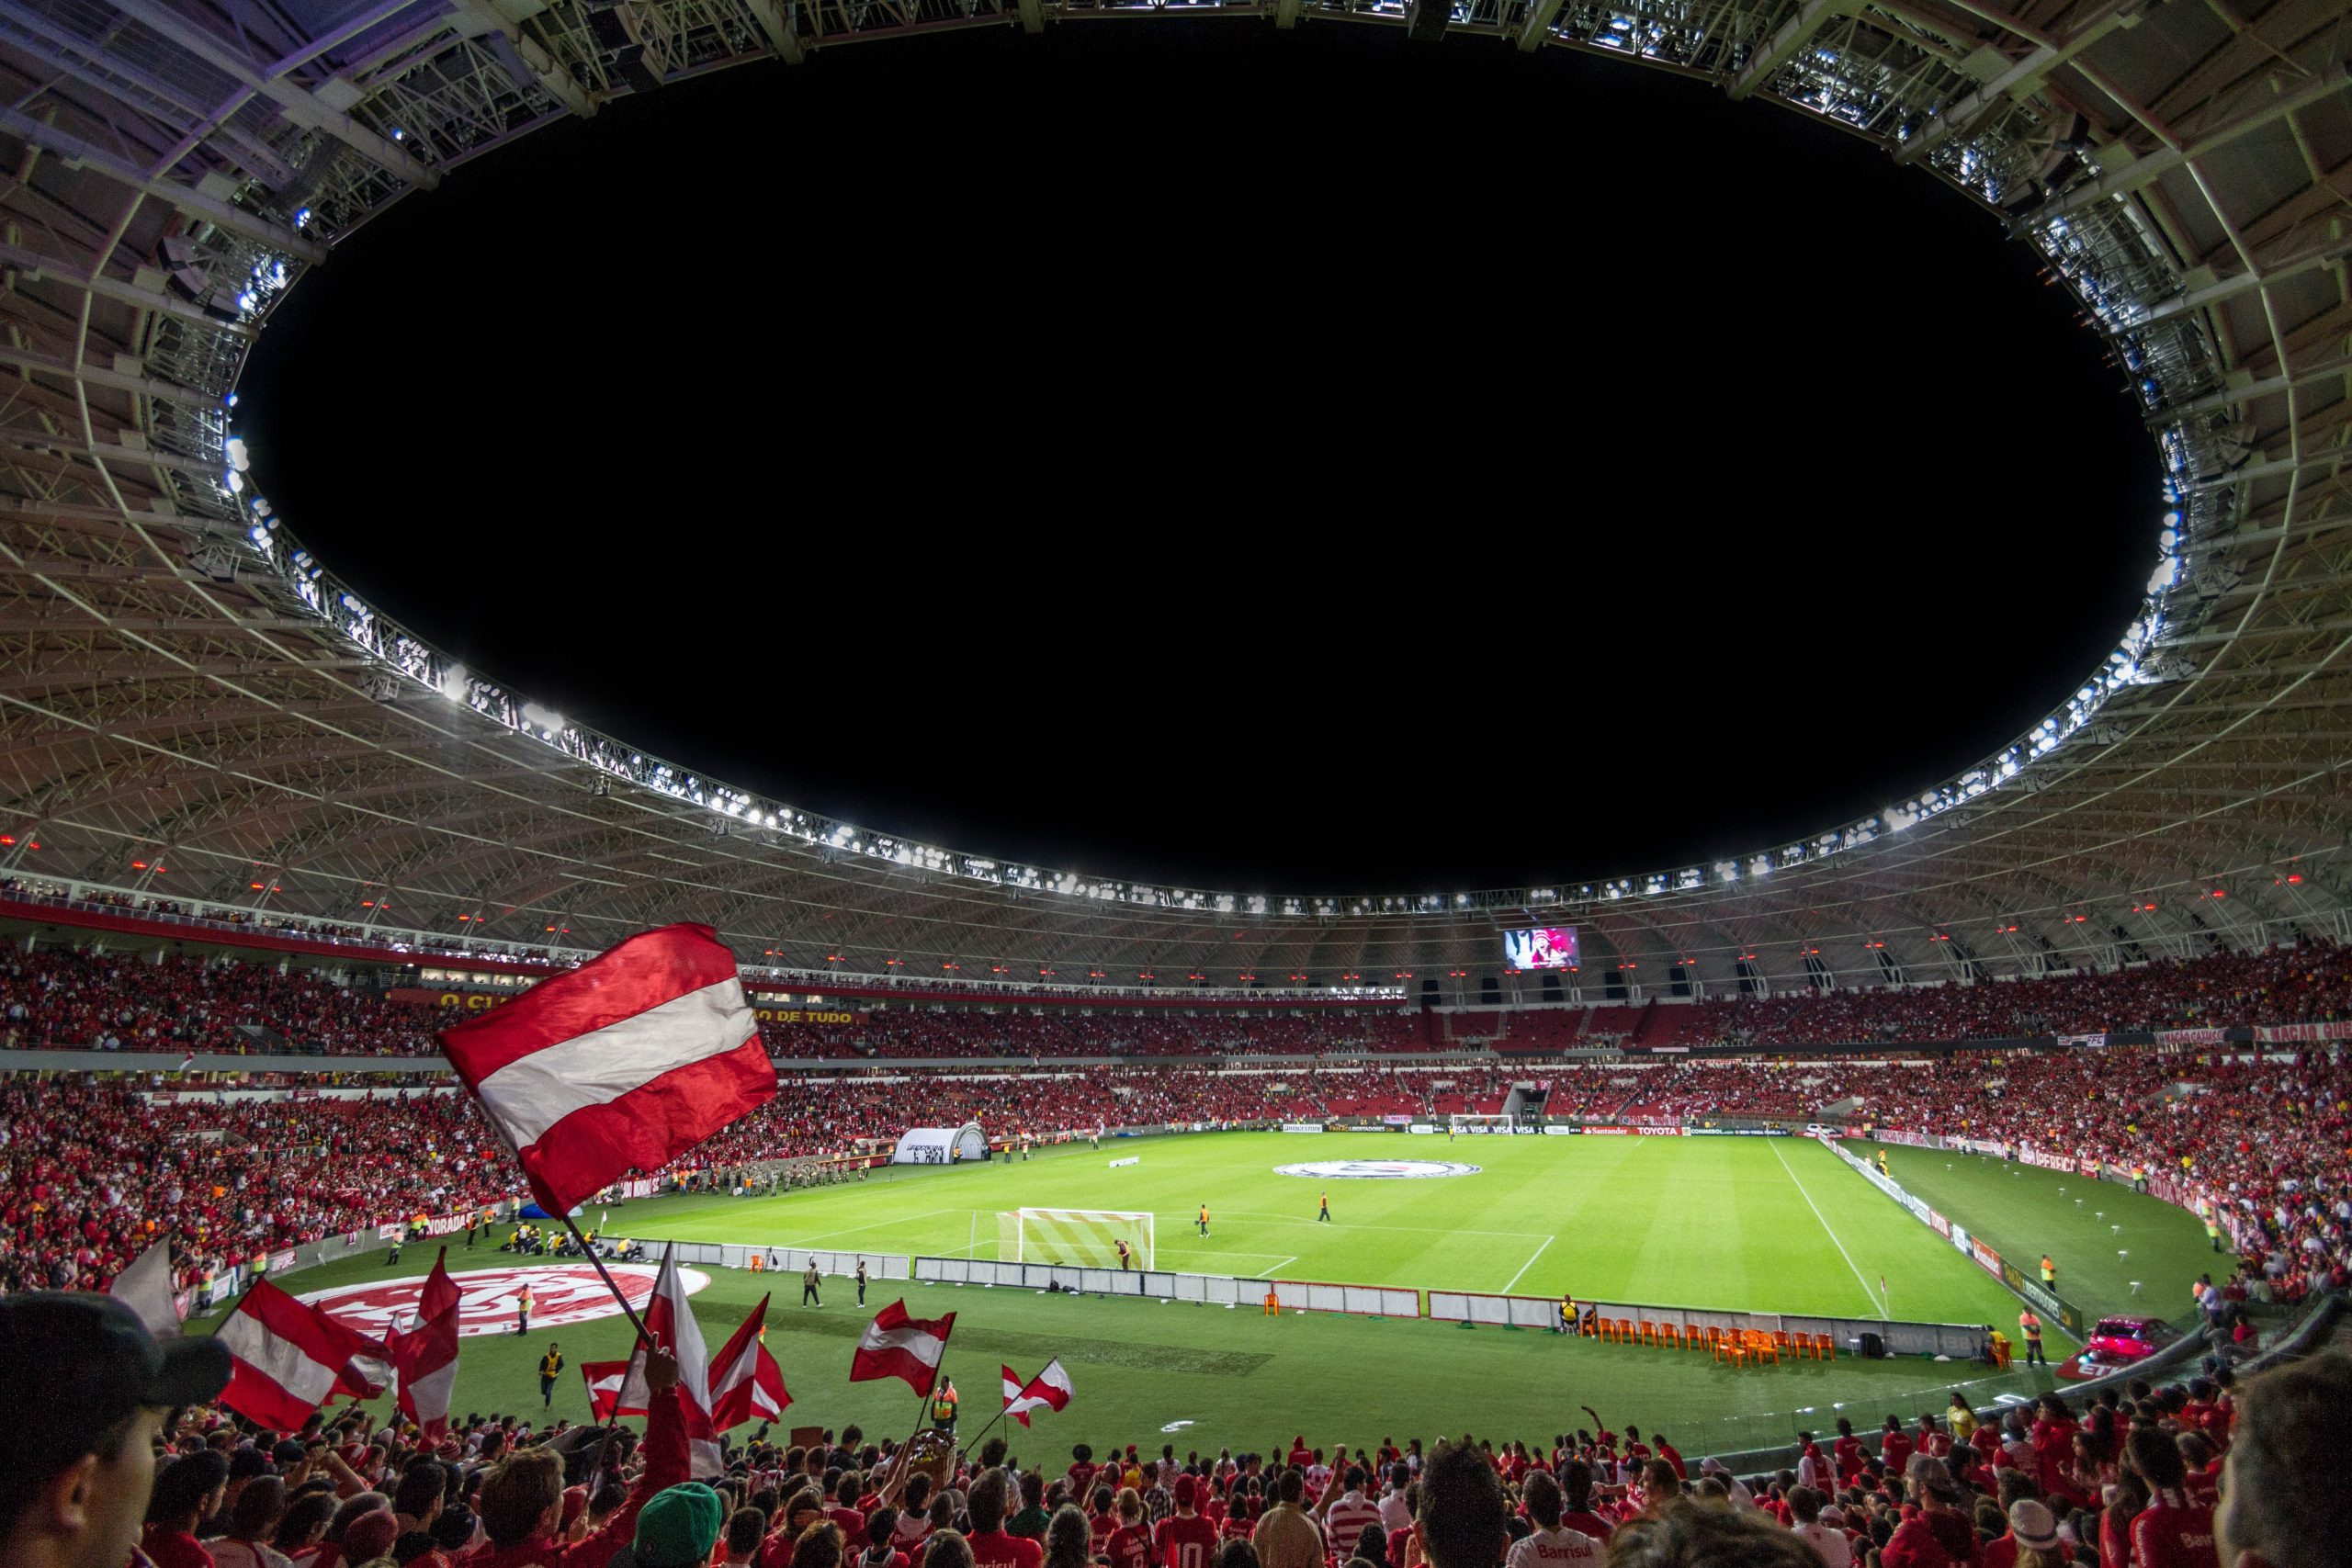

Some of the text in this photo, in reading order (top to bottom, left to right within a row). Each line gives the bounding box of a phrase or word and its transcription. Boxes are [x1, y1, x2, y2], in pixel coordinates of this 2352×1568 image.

[777, 1010, 800, 1021] DE
[807, 1011, 852, 1022] TUDO
[1470, 1125, 1489, 1134] VISA
[1492, 1125, 1511, 1134] VISA
[1515, 1125, 1534, 1134] VISA
[1637, 1127, 1677, 1135] TOYOTA
[1175, 1542, 1203, 1568] 10
